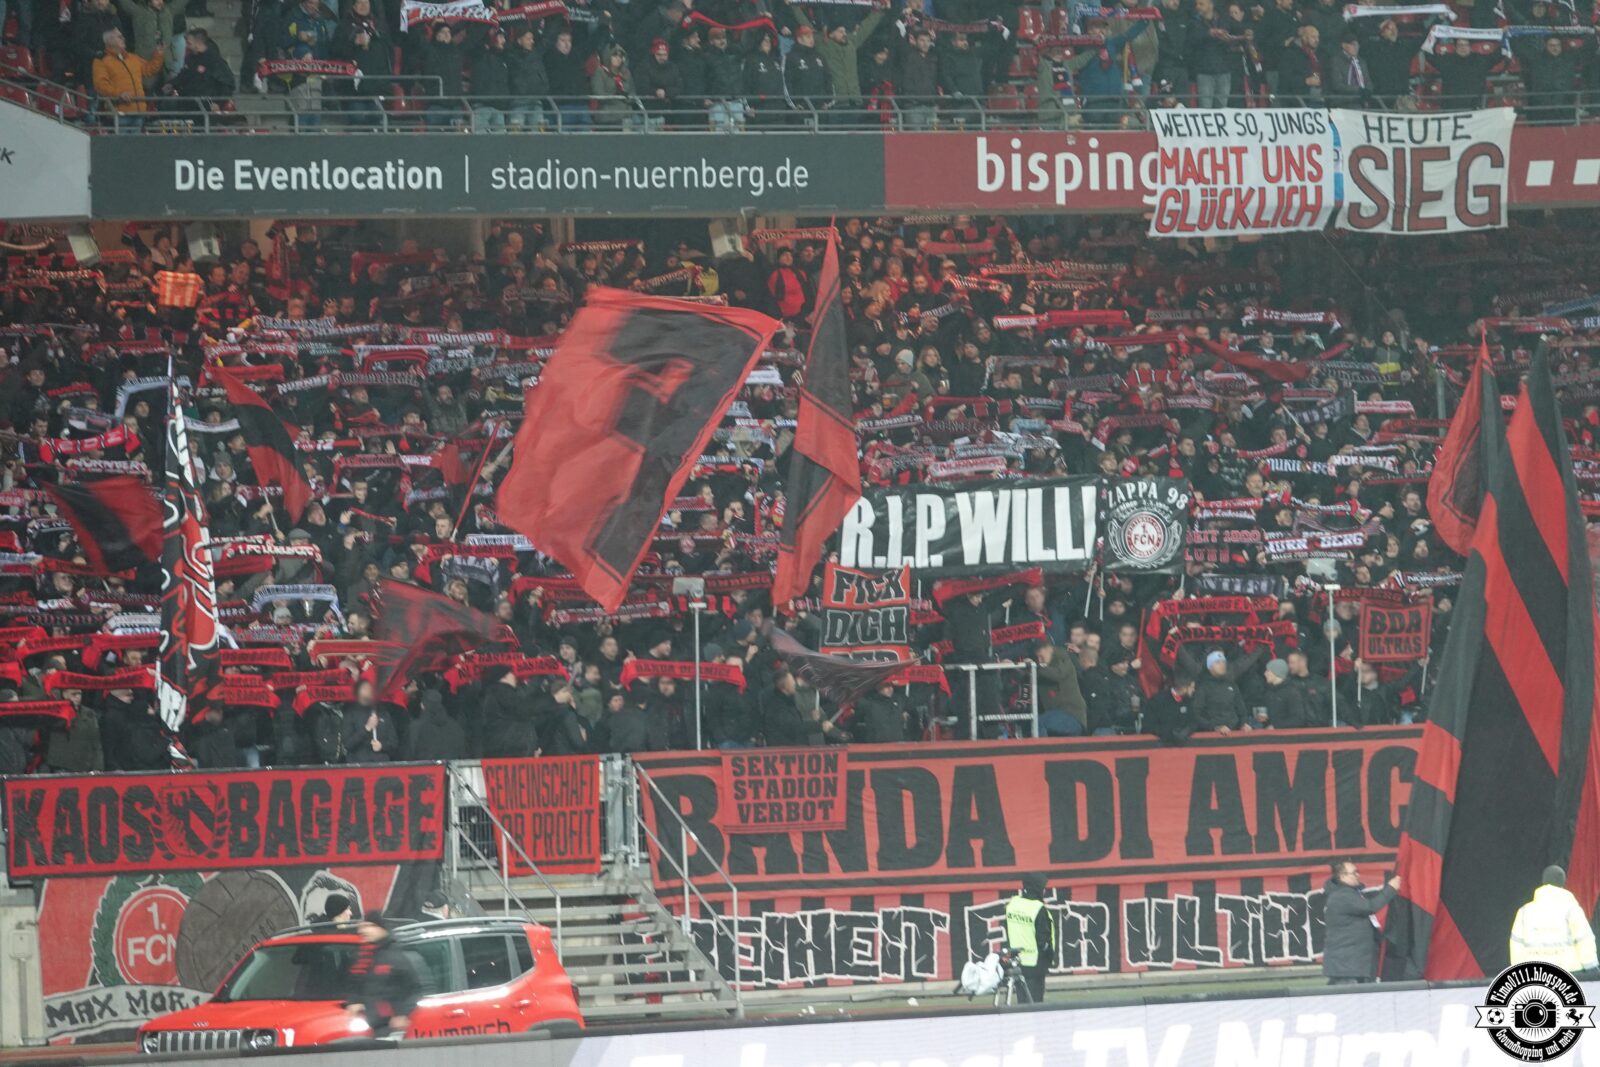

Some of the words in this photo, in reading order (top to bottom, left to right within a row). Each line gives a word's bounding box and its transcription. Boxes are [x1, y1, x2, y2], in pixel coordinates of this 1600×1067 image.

[1156, 112, 1229, 138] WEITER
[1267, 111, 1326, 142] JUNGS
[1362, 114, 1472, 144] HEUTE
[174, 159, 224, 190] Die
[234, 159, 443, 190] Eventlocation
[491, 157, 809, 196] stadion-nuernberg.de
[1159, 146, 1248, 186] MACHT
[1262, 143, 1323, 184] UNS
[1348, 142, 1504, 232] SIEG
[1167, 487, 1188, 510] 98
[955, 486, 1097, 566] WILLI
[1133, 534, 1155, 545] FCN
[824, 607, 908, 646] DICH
[1369, 610, 1422, 635] BDA
[1368, 635, 1422, 656] ULTRAS
[731, 752, 839, 777] SEKTION
[485, 760, 595, 811] GEMEINSCHAFT
[733, 776, 839, 801] STADION
[1044, 756, 1155, 864] DI
[1186, 745, 1418, 862] AMIC
[12, 784, 157, 867] KAOS
[227, 773, 436, 859] BAGAGE
[737, 800, 834, 824] VERBOT
[532, 810, 595, 857] PROFIT
[964, 888, 1110, 975] FR
[45, 993, 117, 1028] MAX
[125, 989, 199, 1016] MOR
